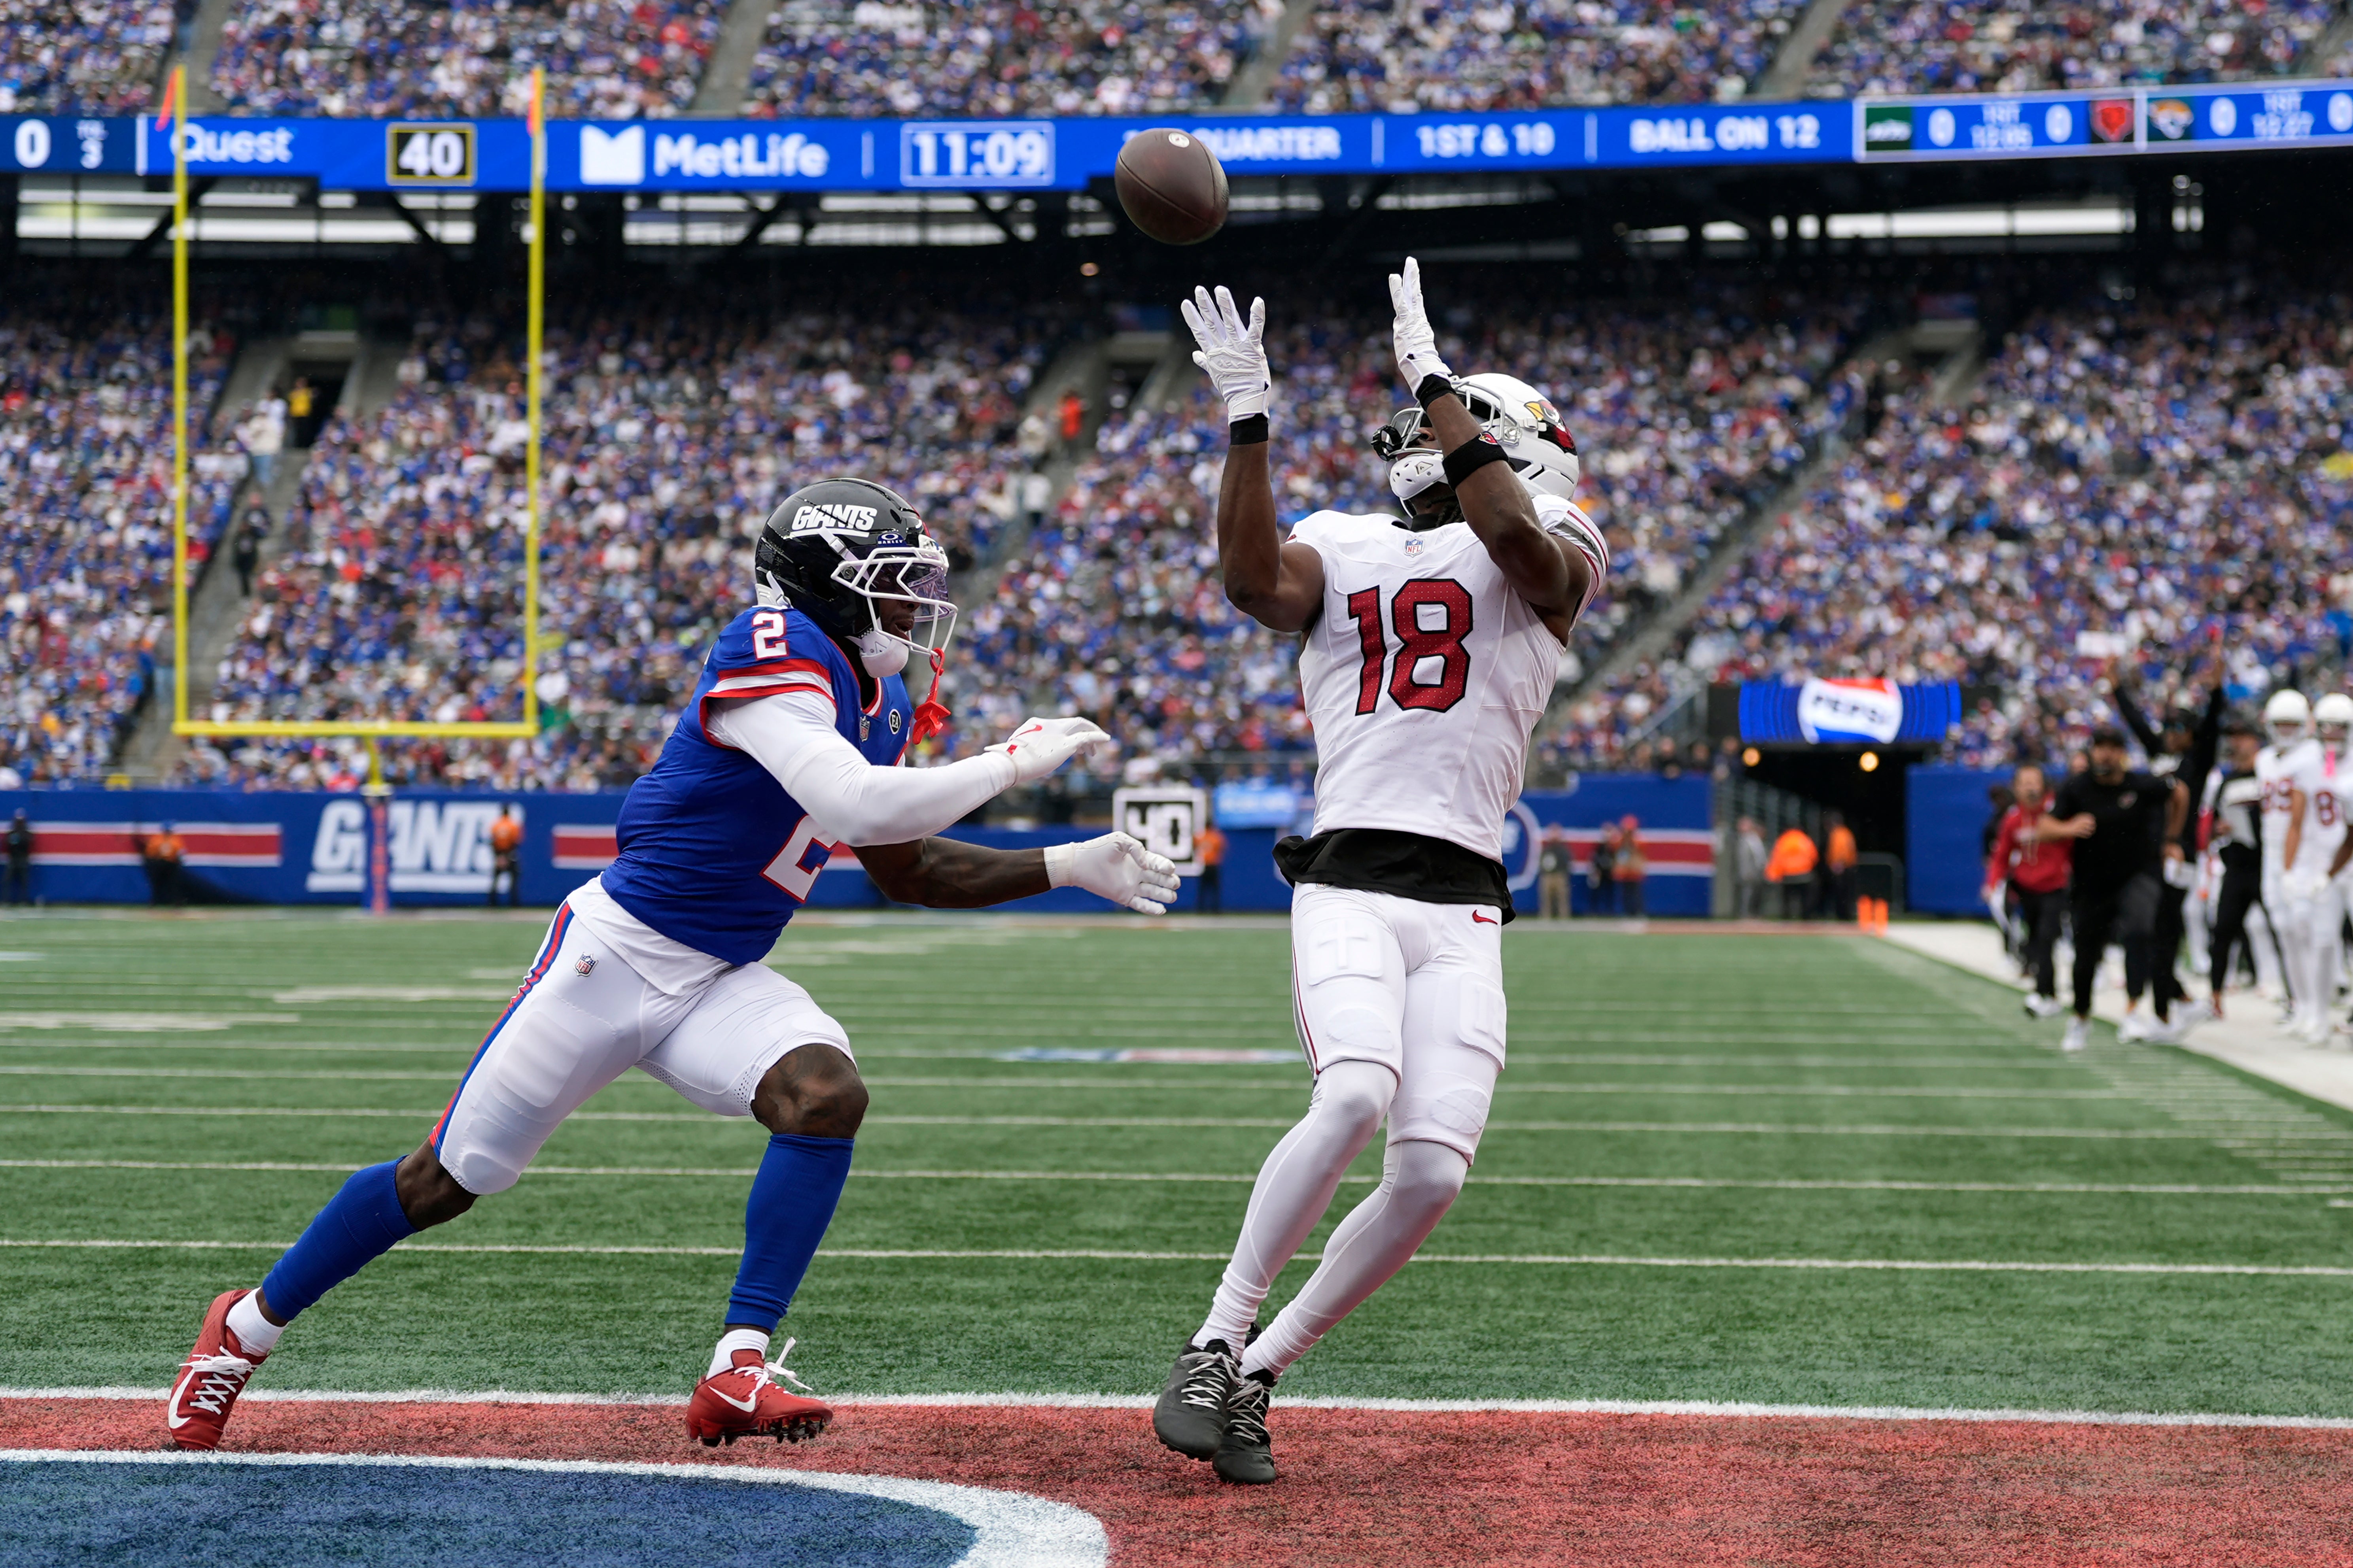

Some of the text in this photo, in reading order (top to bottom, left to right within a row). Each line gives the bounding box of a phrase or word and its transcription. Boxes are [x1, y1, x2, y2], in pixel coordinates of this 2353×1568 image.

[1928, 108, 1956, 147] 0
[2045, 104, 2072, 143] 0
[2209, 96, 2237, 136] 0
[2328, 93, 2353, 132] 0
[15, 119, 52, 168] 0
[170, 123, 294, 163] Quest
[913, 131, 1045, 176] 11:09
[1416, 123, 1555, 157] 1ST & 10
[1629, 114, 1820, 153] BALL ON 12
[397, 131, 465, 177] 40
[654, 132, 830, 177] MetLife
[791, 504, 878, 530] GIANTS
[752, 612, 789, 660] 2
[1348, 578, 1473, 716] 18
[312, 799, 526, 874] GANTS
[577, 961, 589, 973] NFL
